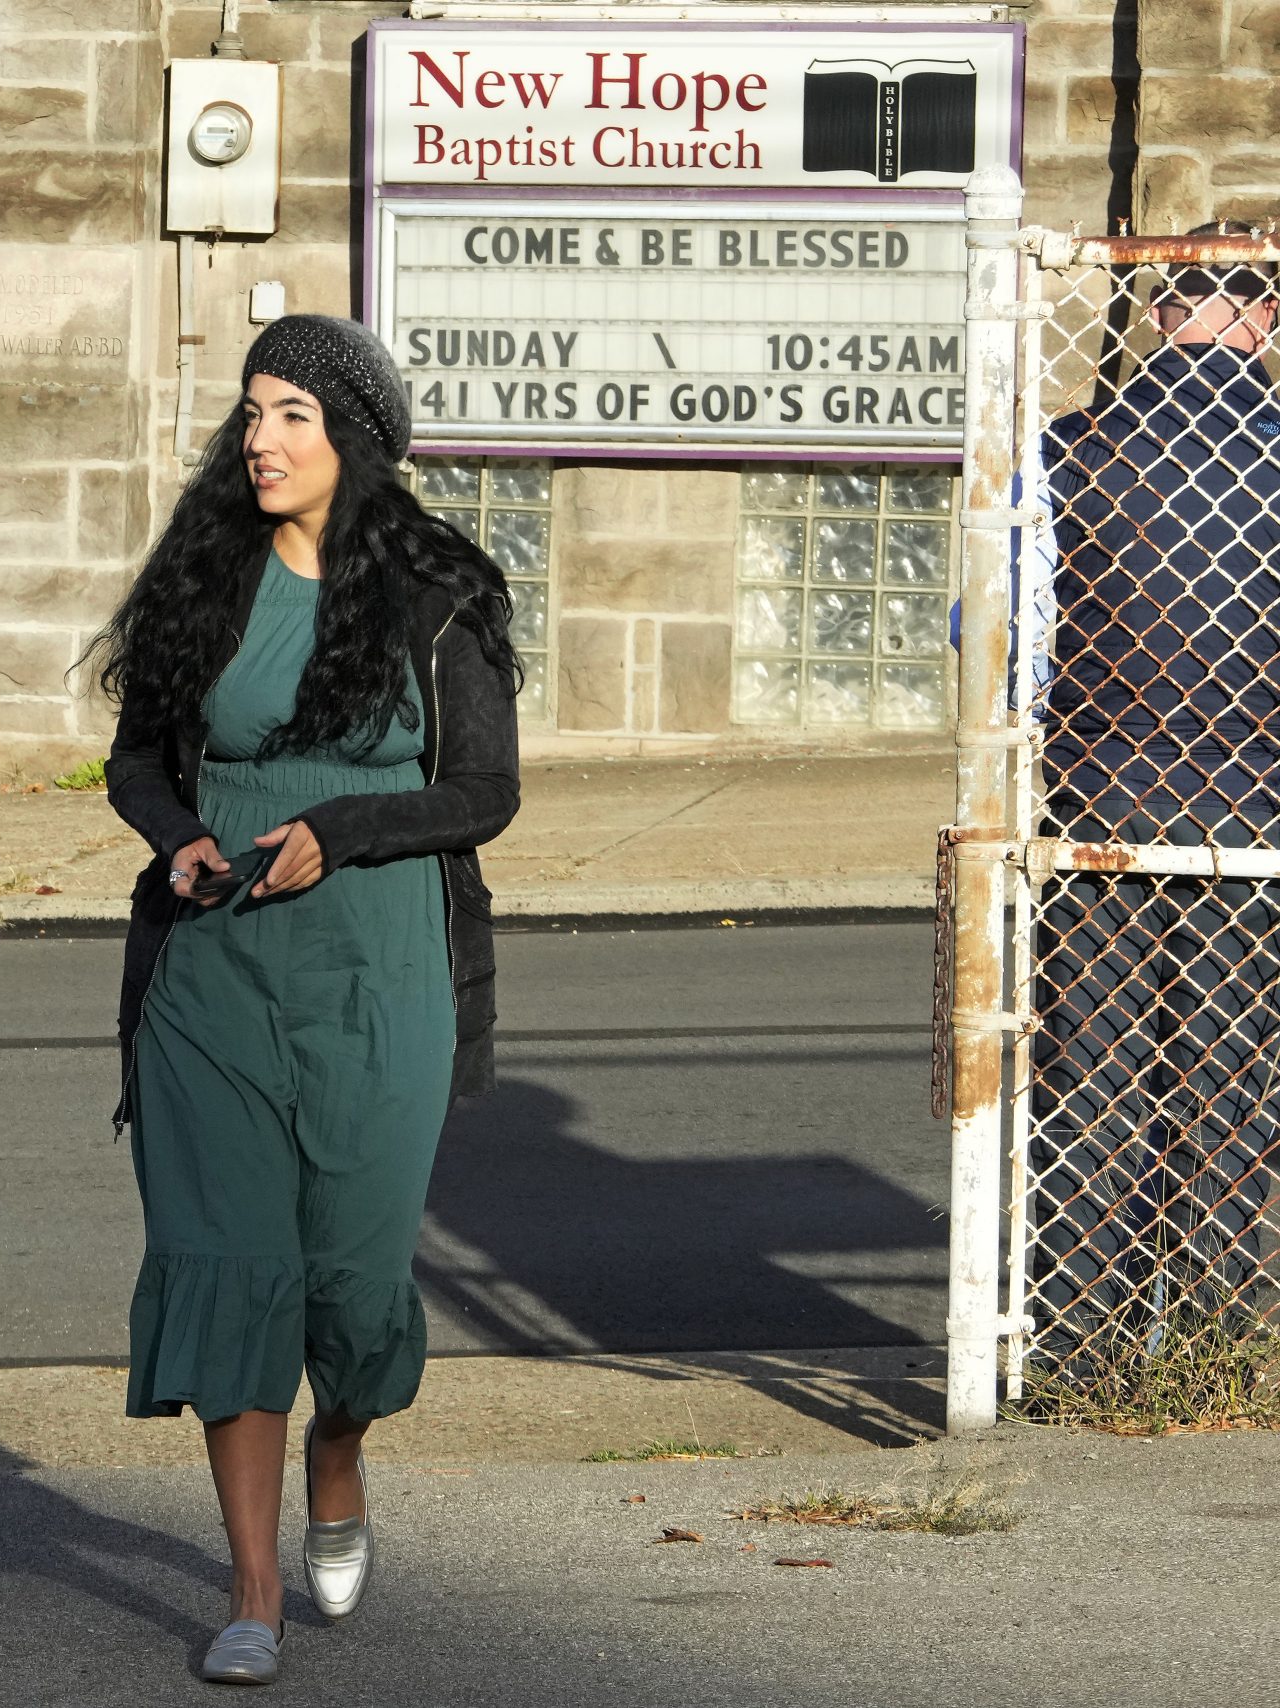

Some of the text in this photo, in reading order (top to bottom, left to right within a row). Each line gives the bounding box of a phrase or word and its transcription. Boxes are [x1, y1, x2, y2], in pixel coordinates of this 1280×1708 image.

[408, 51, 767, 132] New Hope
[413, 124, 763, 180] Baptist Church
[884, 86, 895, 176] HOLY BIBLE
[464, 225, 909, 268] COME & BE BLESSED
[408, 328, 578, 368] SUNDAY
[766, 332, 959, 373] 10:45AM
[492, 381, 577, 419] YRS
[596, 382, 650, 421] OF
[670, 383, 803, 423] GOD'S
[822, 385, 965, 425] GRACE
